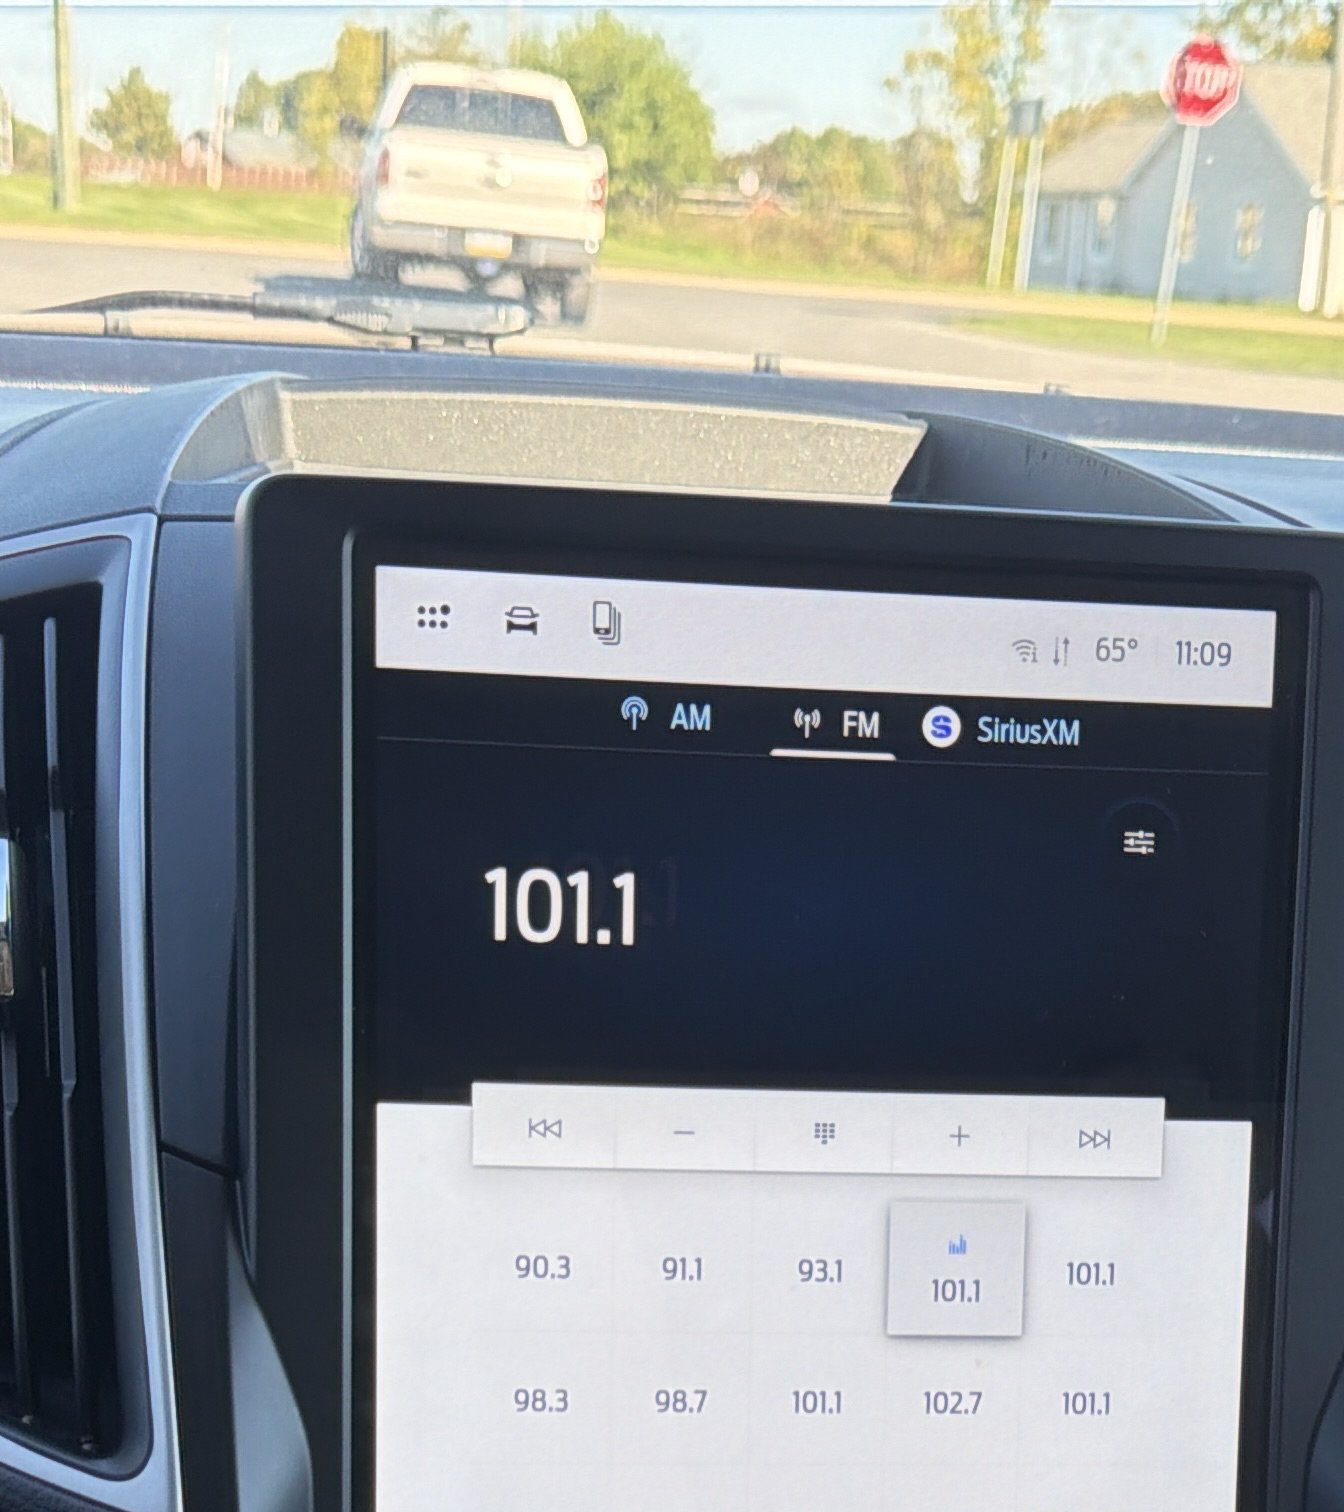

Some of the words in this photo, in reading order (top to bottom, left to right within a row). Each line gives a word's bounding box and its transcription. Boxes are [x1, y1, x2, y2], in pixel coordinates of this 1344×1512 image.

[1096, 637, 1137, 662] 65°
[1176, 641, 1231, 666] 11:09
[671, 703, 710, 730] AM
[843, 711, 879, 738] FM
[977, 716, 1079, 745] SiriusXM
[485, 867, 634, 945] 101.1
[516, 1255, 570, 1279] 90.3
[663, 1257, 701, 1280] 91.1
[799, 1259, 842, 1282] 93.1
[1067, 1262, 1114, 1285] 101.1
[933, 1279, 980, 1302] 101.1
[515, 1389, 568, 1412] 98.3
[656, 1390, 707, 1413] 98.7
[793, 1391, 841, 1413] 101.1
[924, 1391, 982, 1414] 102.7
[1063, 1392, 1110, 1415] 101.1
